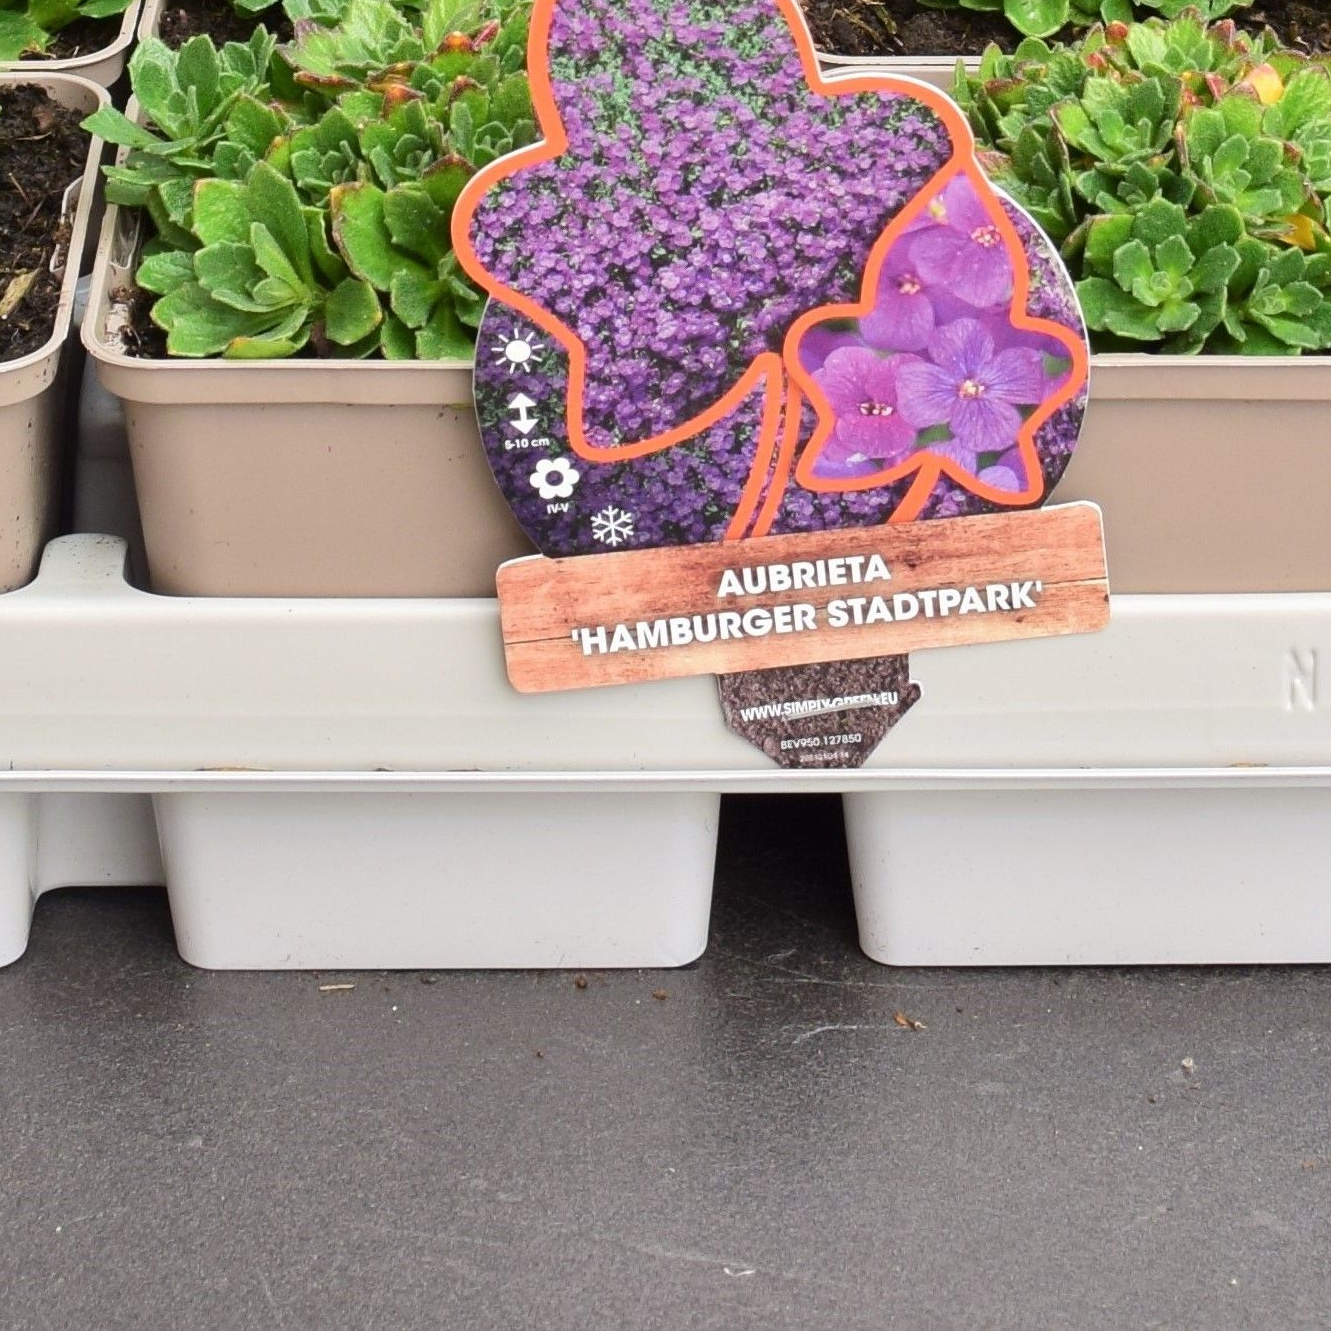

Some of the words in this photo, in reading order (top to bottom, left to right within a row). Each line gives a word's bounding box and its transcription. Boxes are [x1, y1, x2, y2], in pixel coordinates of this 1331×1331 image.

[530, 438, 550, 448] cm
[546, 502, 569, 515] IV-V
[716, 553, 891, 598] AUBRIETA
[571, 601, 817, 656] 'HAMBURGER
[827, 579, 1044, 629] STADTPARK'
